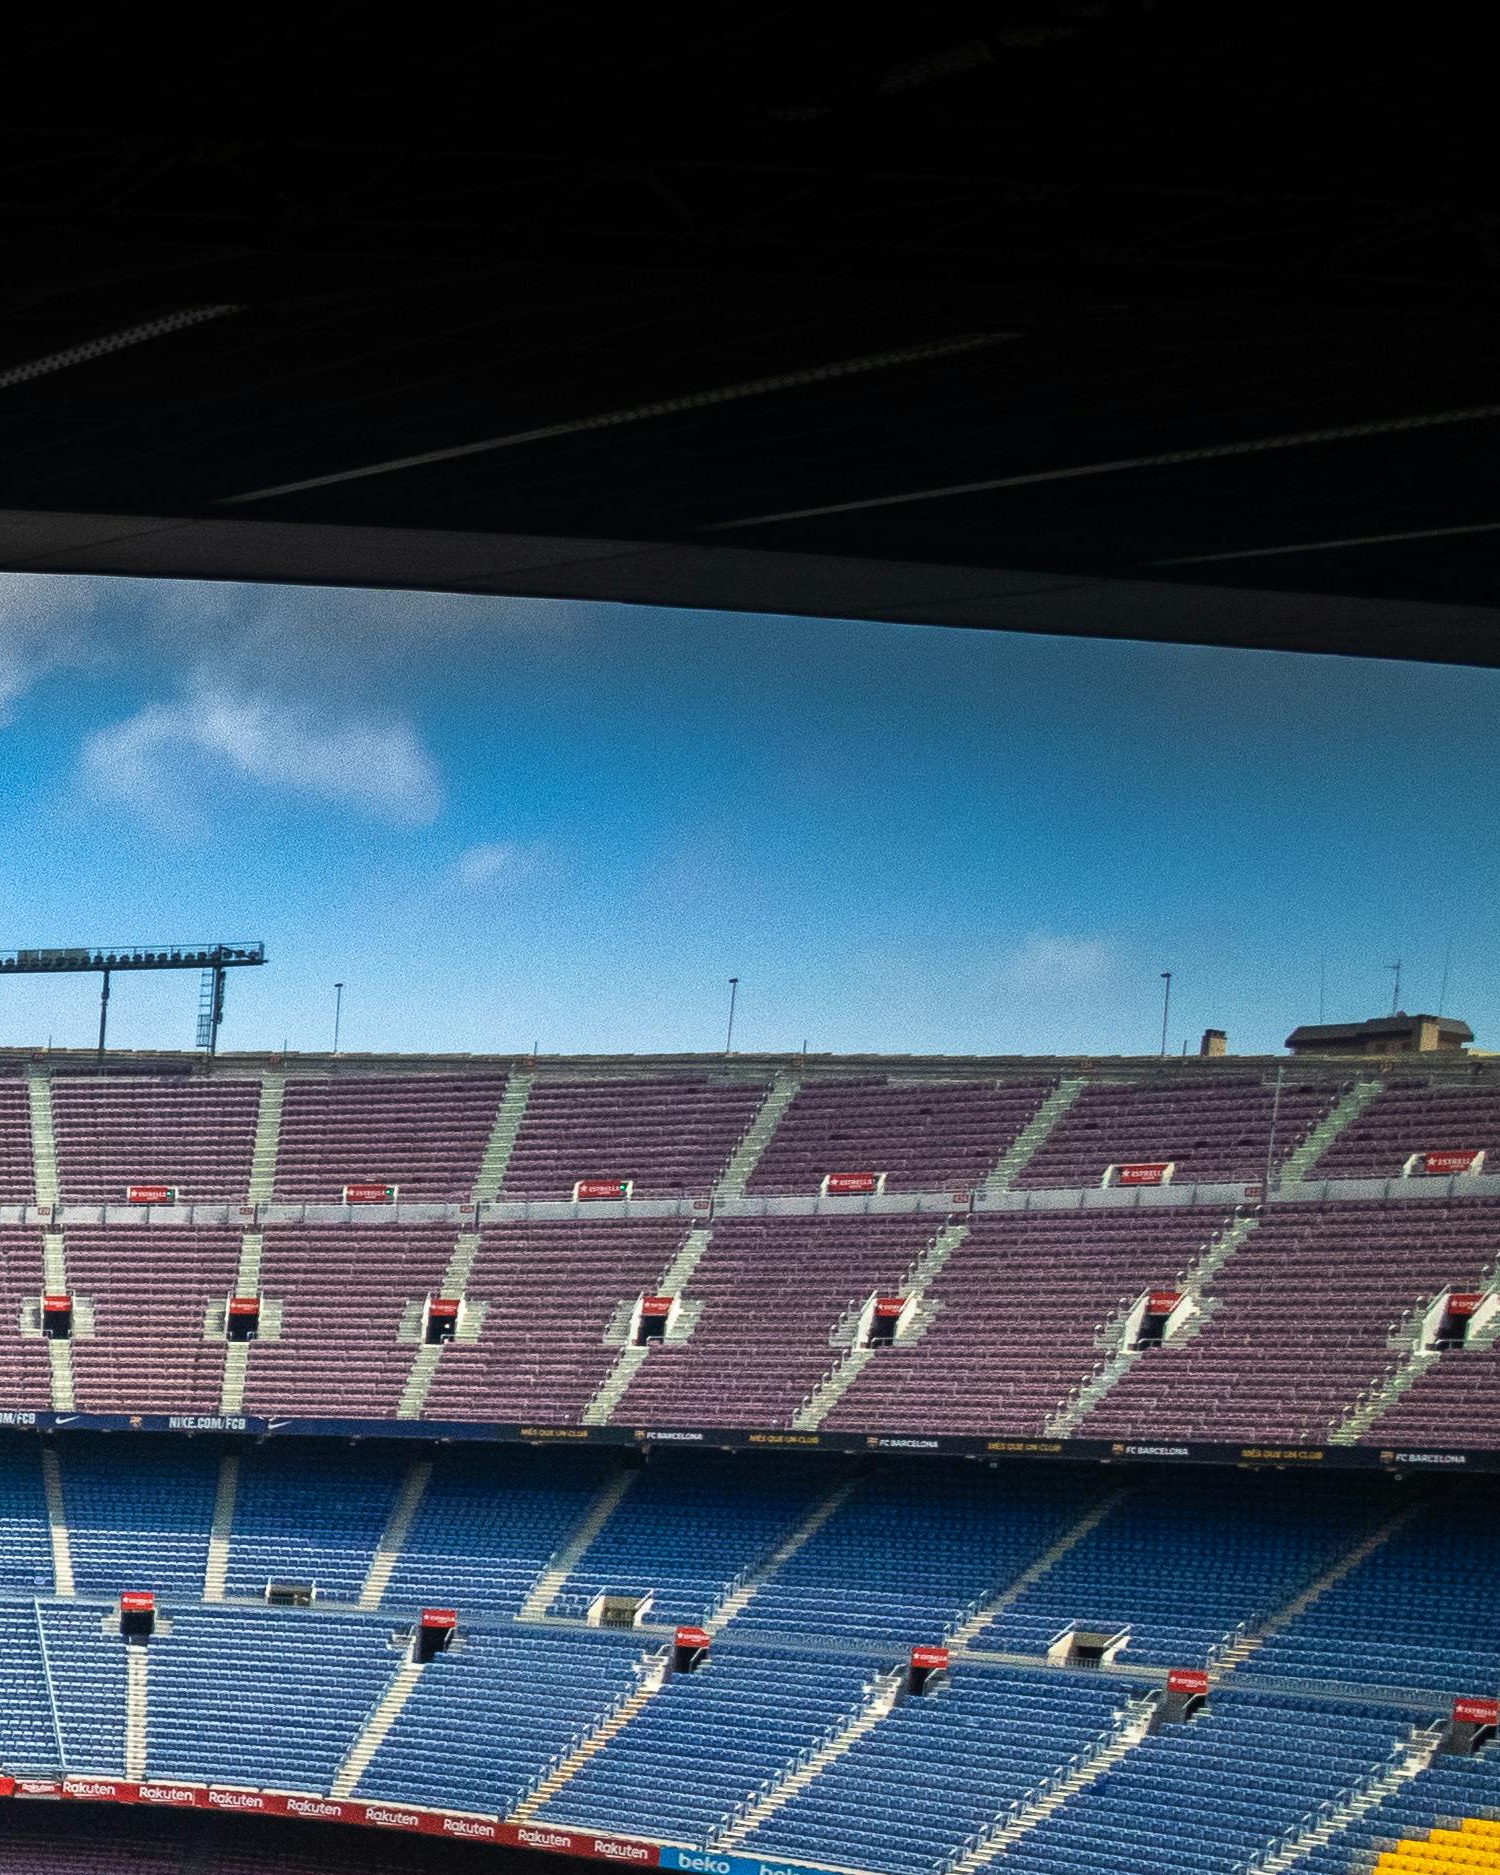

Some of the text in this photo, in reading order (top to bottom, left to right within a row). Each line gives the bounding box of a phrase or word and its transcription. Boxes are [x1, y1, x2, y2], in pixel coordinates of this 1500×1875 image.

[62, 1780, 115, 1797] Rakuten
[139, 1787, 192, 1805] Rakuten
[209, 1792, 263, 1808] Rakuten
[287, 1799, 341, 1816] Rakuten
[366, 1807, 418, 1825] Rakuten
[444, 1819, 494, 1836] Rakuten
[518, 1829, 570, 1847] Rakuten
[595, 1840, 647, 1859] Rakuten
[679, 1853, 729, 1873] beko
